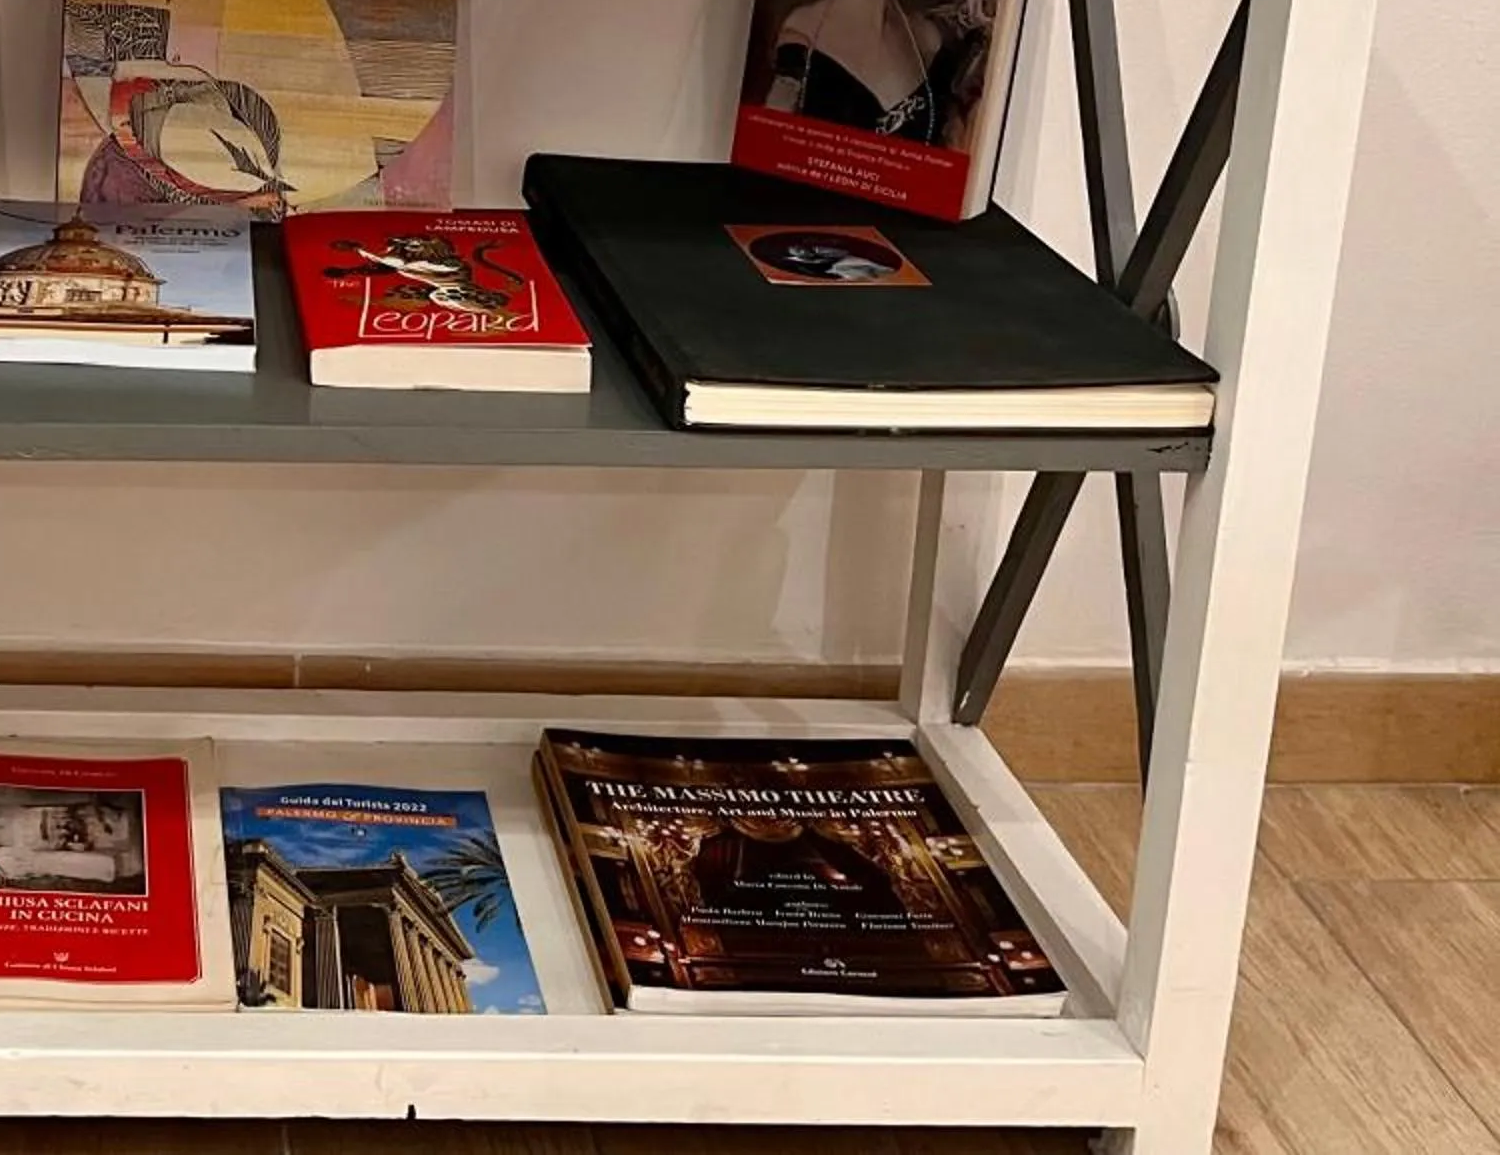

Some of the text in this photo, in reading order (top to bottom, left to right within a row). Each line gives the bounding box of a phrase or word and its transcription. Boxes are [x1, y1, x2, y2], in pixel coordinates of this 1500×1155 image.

[115, 223, 241, 238] Palermo
[586, 780, 925, 805] THE MASSIMO THEATRE
[280, 796, 319, 806] Guida
[345, 797, 390, 810] Turista
[394, 802, 427, 812] 2022
[717, 806, 745, 817] Art
[747, 807, 775, 817] and
[779, 807, 826, 818] Music
[831, 808, 846, 818] in
[849, 808, 917, 818] Palermo
[53, 898, 148, 912] SCLAFANI
[9, 909, 114, 924] IN CUCINA
